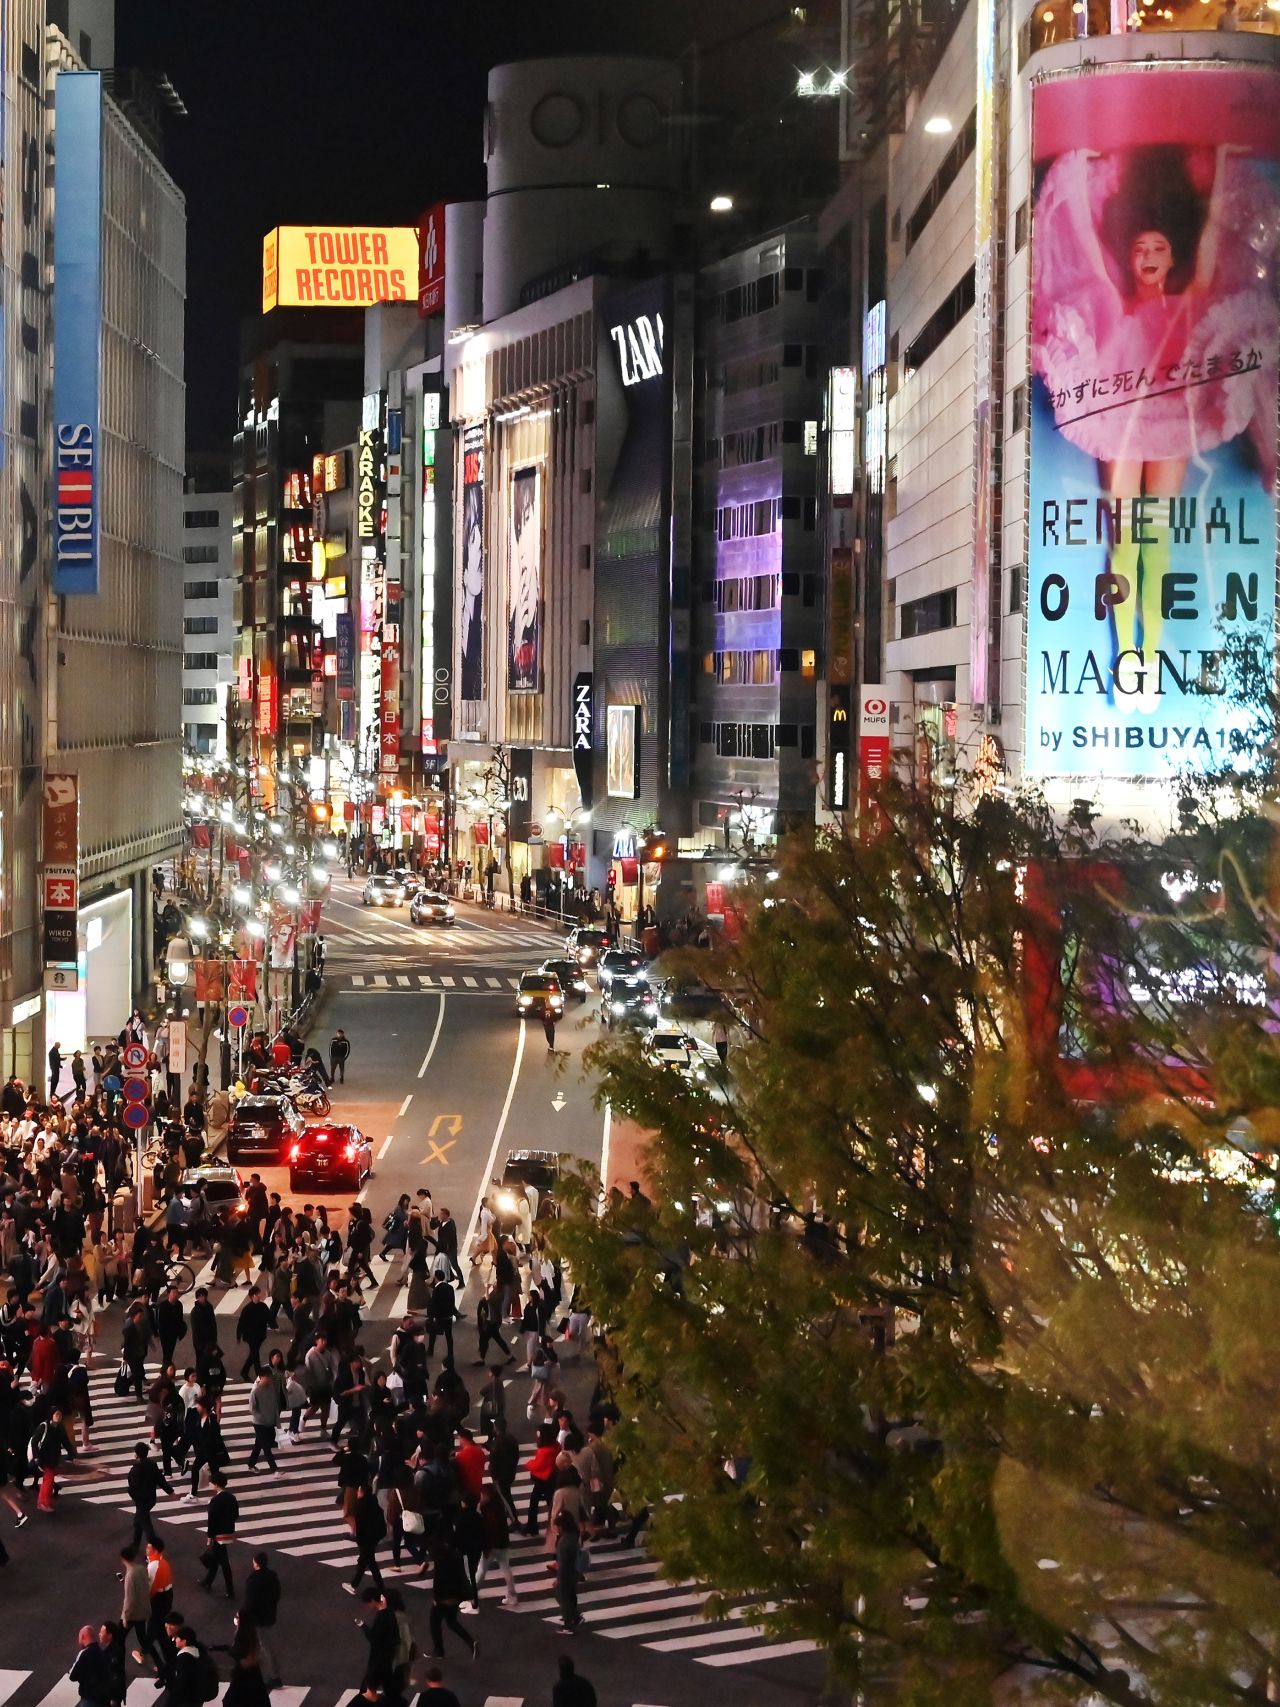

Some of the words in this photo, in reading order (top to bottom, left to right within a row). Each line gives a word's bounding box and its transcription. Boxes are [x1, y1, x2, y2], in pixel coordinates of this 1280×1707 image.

[305, 233, 389, 265] TOWER
[296, 268, 407, 301] RECORDS
[57, 424, 93, 561] SEIBU
[358, 431, 374, 537] KARAOKE
[1043, 497, 1261, 546] RENEWAL
[1040, 572, 1258, 622] OPEN
[574, 685, 593, 749] ZARA
[863, 716, 886, 724] MUFG
[1040, 727, 1063, 752] by
[45, 867, 76, 875] TSUTAYA
[49, 882, 72, 904] 本
[48, 929, 73, 937] WIRED
